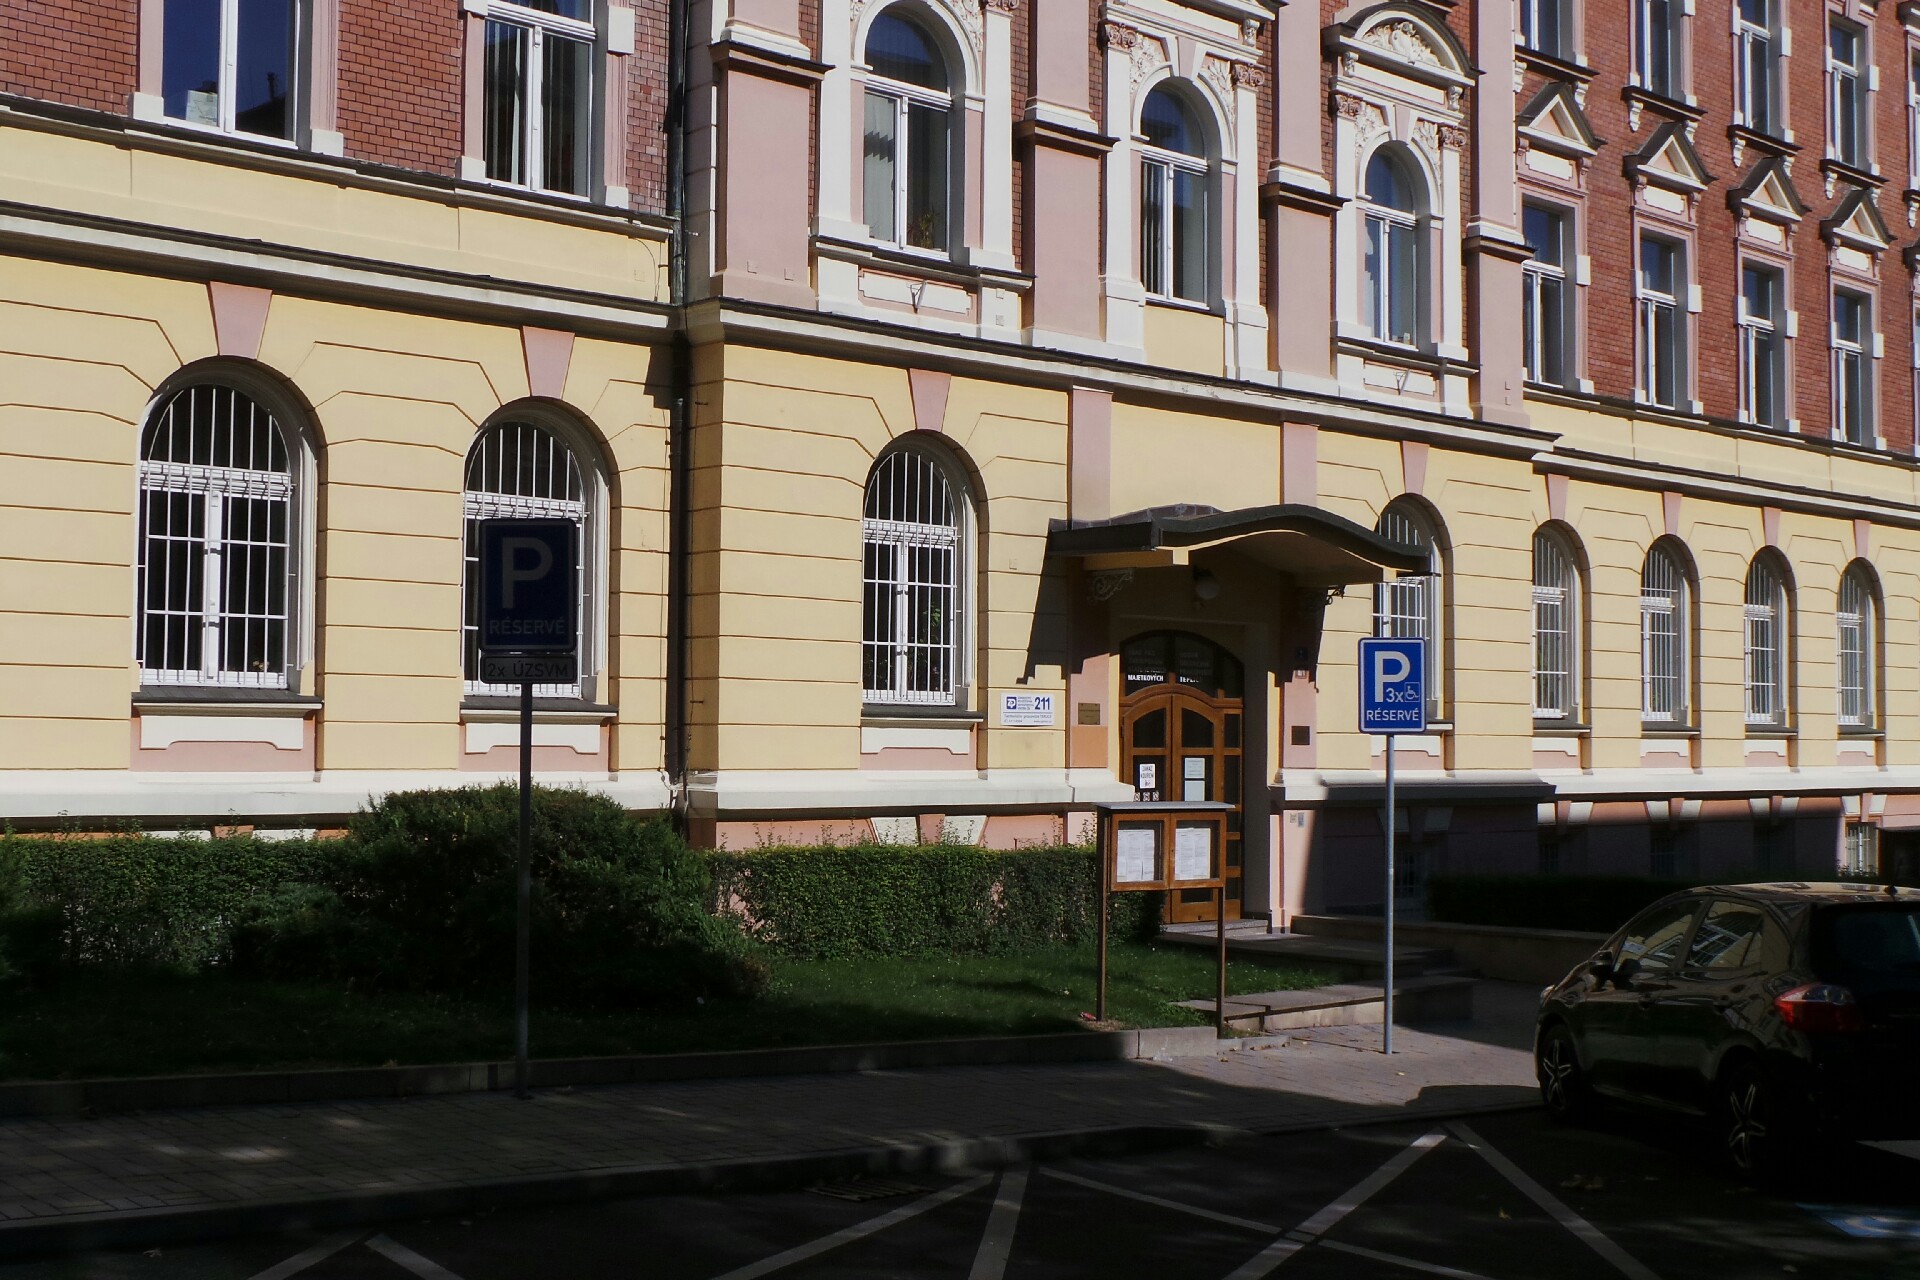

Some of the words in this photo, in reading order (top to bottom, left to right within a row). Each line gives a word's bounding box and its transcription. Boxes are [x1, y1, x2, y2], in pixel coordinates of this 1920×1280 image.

[502, 536, 554, 609] P
[489, 616, 565, 635] RÉSERVÉ
[487, 662, 506, 678] 2x
[513, 660, 568, 678] ÚZSVM
[1374, 650, 1411, 702] P
[1034, 696, 1050, 711] 211
[1386, 687, 1404, 702] 3x
[1366, 707, 1419, 721] RÉSERVÉ
